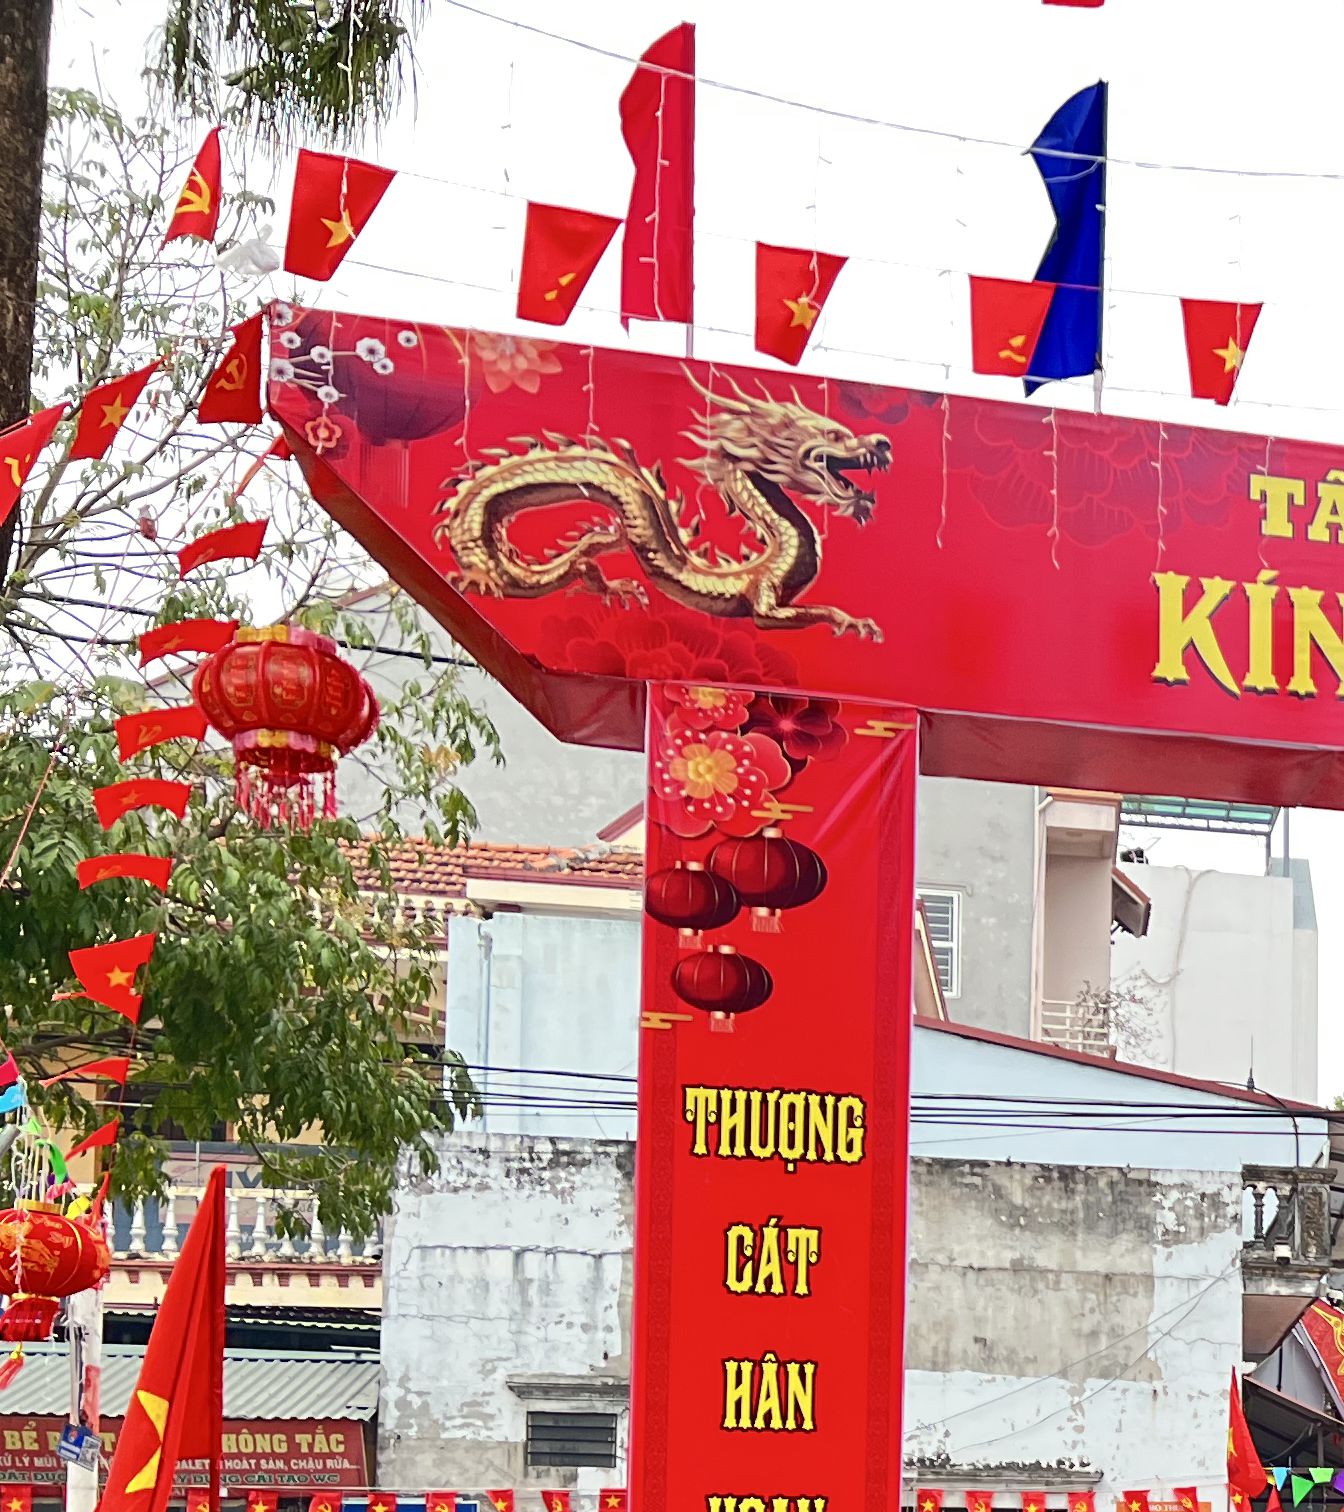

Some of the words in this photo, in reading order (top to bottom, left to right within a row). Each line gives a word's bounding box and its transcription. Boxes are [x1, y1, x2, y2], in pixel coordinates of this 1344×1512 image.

[686, 1088, 864, 1171] THƯỢNG
[727, 1218, 818, 1294] CÁT
[724, 1354, 814, 1430] HÂN
[222, 1429, 288, 1453] HÔNG
[295, 1425, 345, 1453] TẮC
